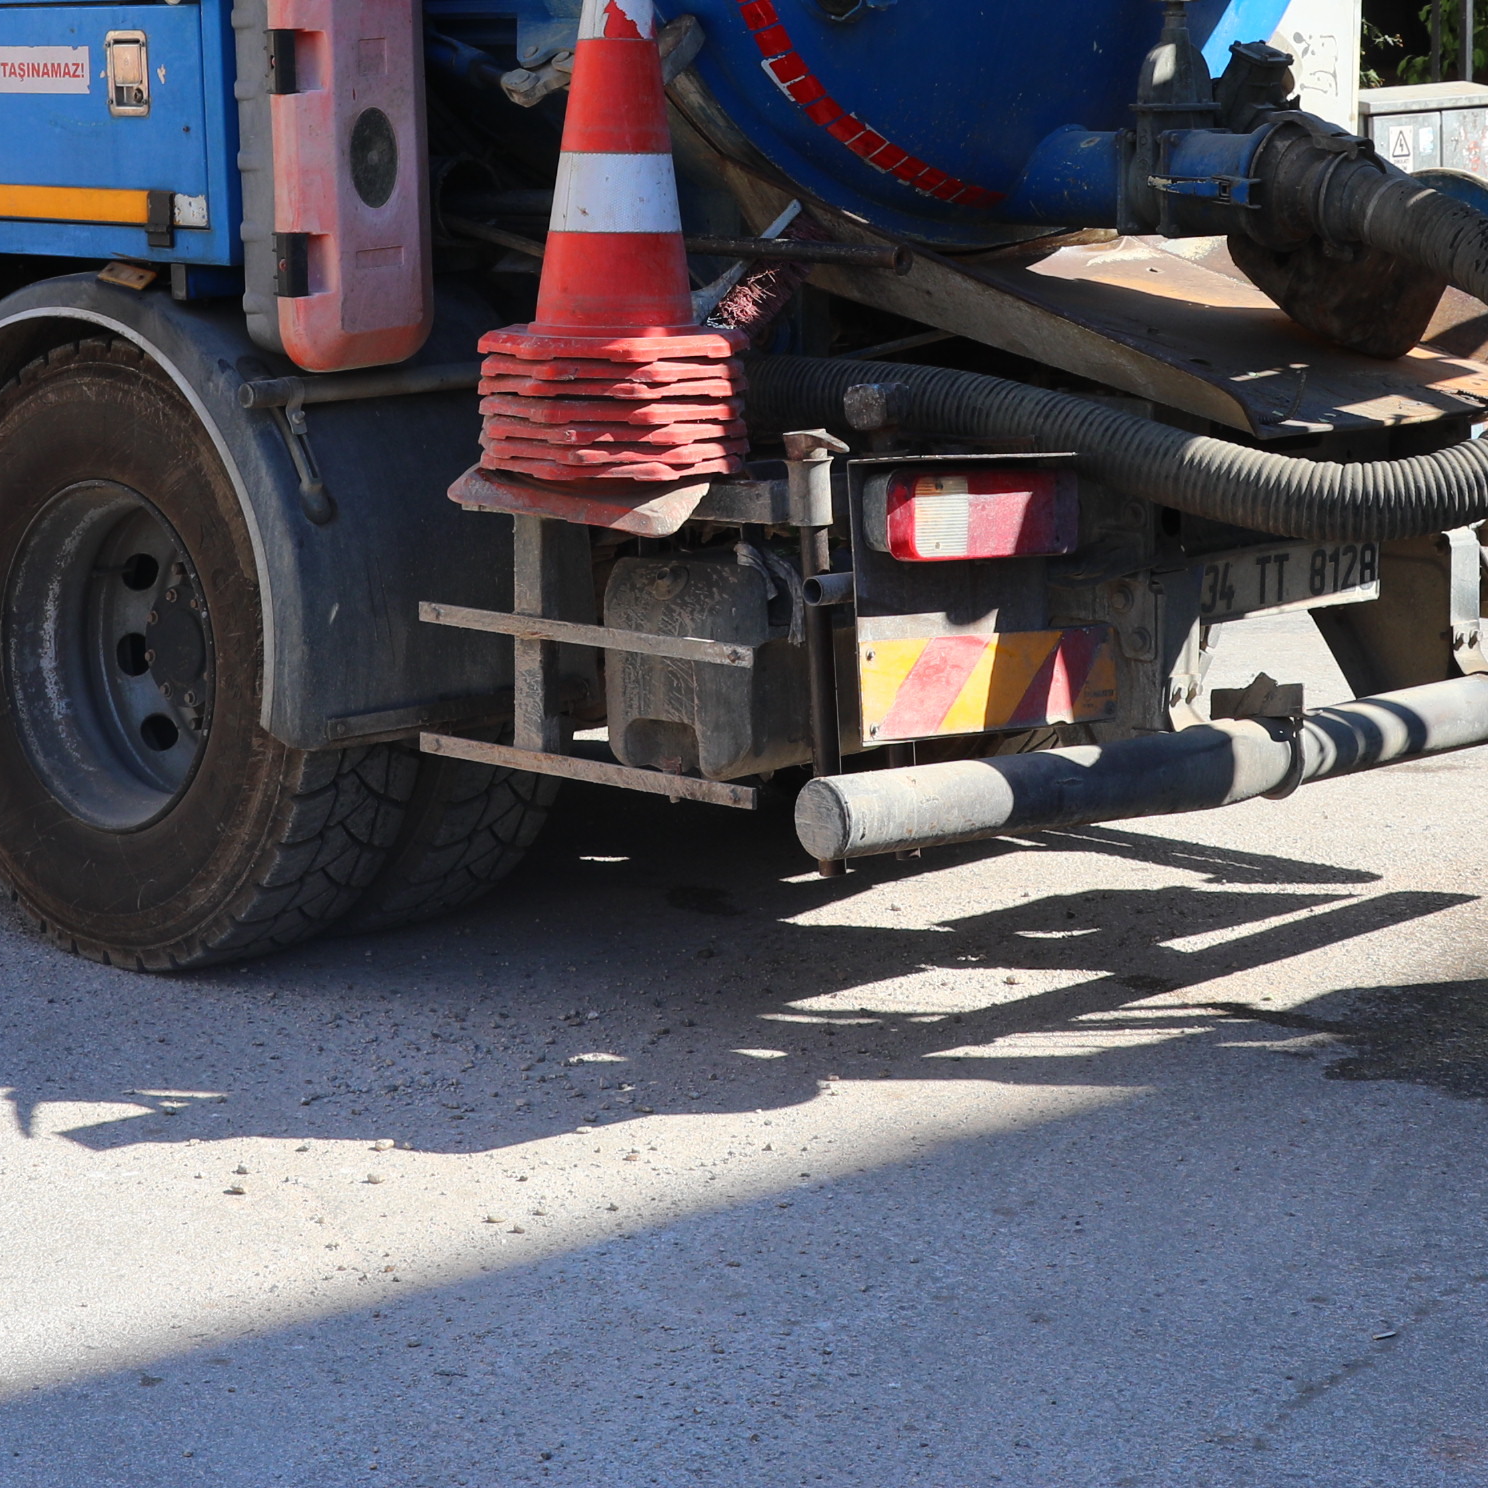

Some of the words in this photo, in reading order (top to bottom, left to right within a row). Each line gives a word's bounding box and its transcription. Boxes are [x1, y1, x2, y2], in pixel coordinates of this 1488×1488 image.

[0, 62, 85, 81] TAŞINAMAZ!
[1200, 562, 1235, 614] 34
[1255, 552, 1290, 605] TT
[1309, 542, 1377, 597] 8128
